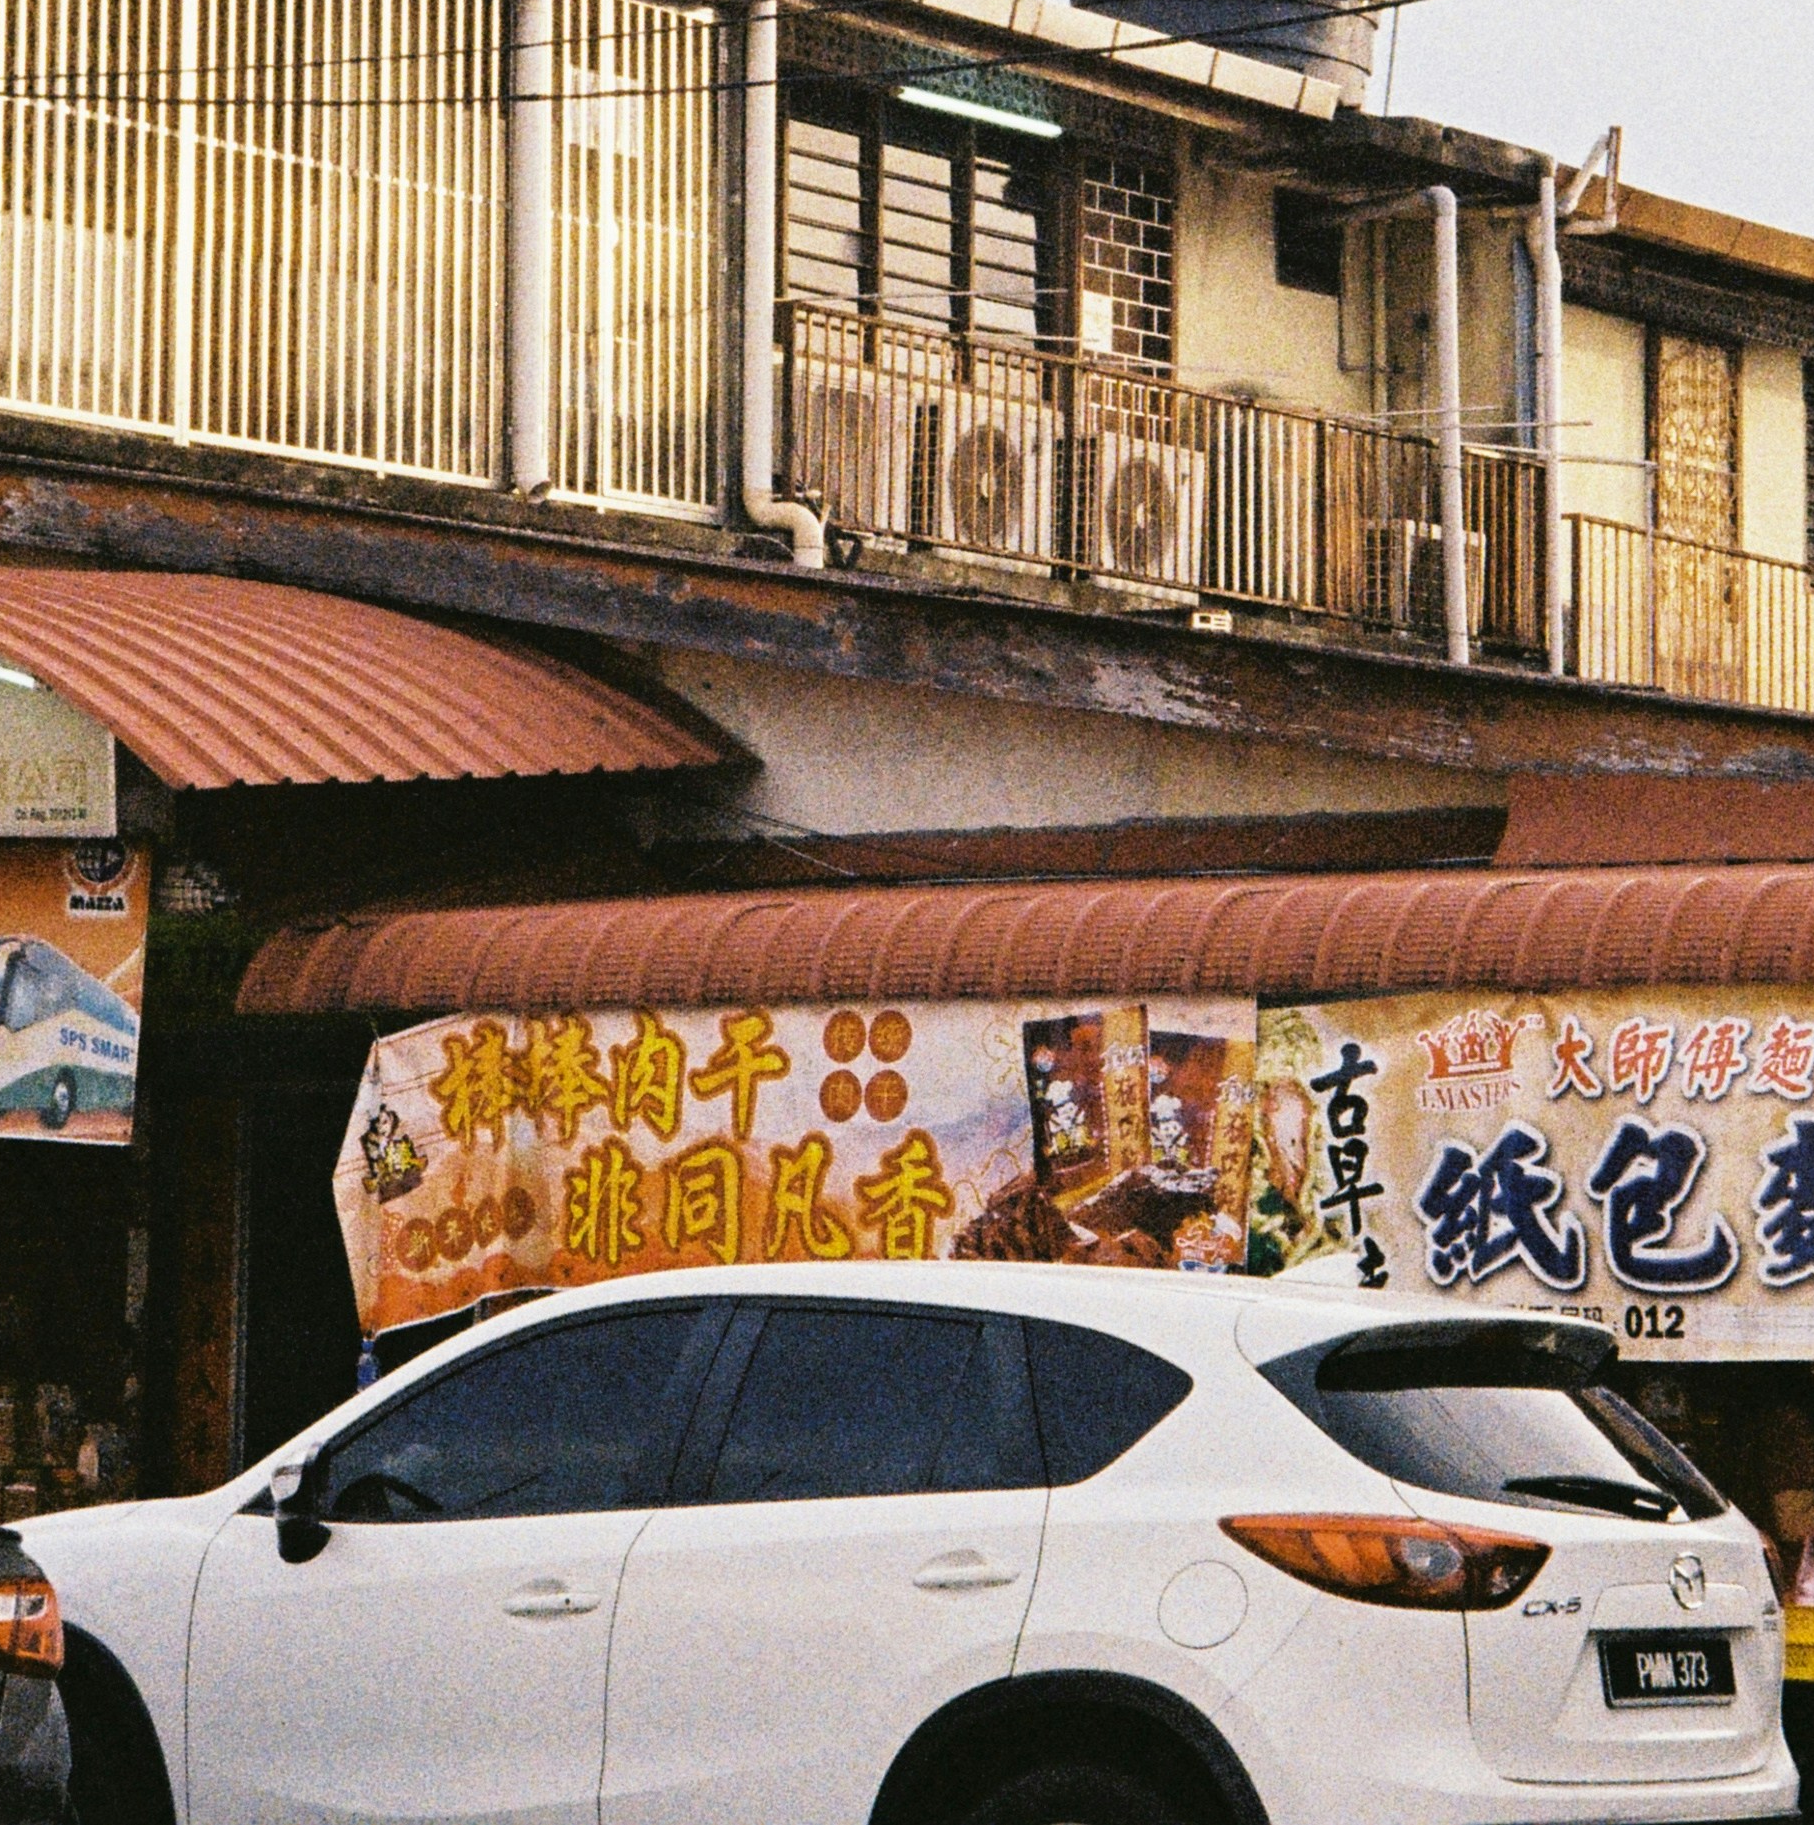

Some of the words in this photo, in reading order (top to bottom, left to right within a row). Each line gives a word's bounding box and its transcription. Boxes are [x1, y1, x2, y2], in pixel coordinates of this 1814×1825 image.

[59, 1027, 87, 1052] SPS
[433, 1012, 787, 1148] 棒棒肉干
[568, 1136, 947, 1264] 非同凡香
[1624, 1304, 1686, 1339] 012
[1522, 1596, 1582, 1617] CX-5
[1677, 1650, 1710, 1688] 373
